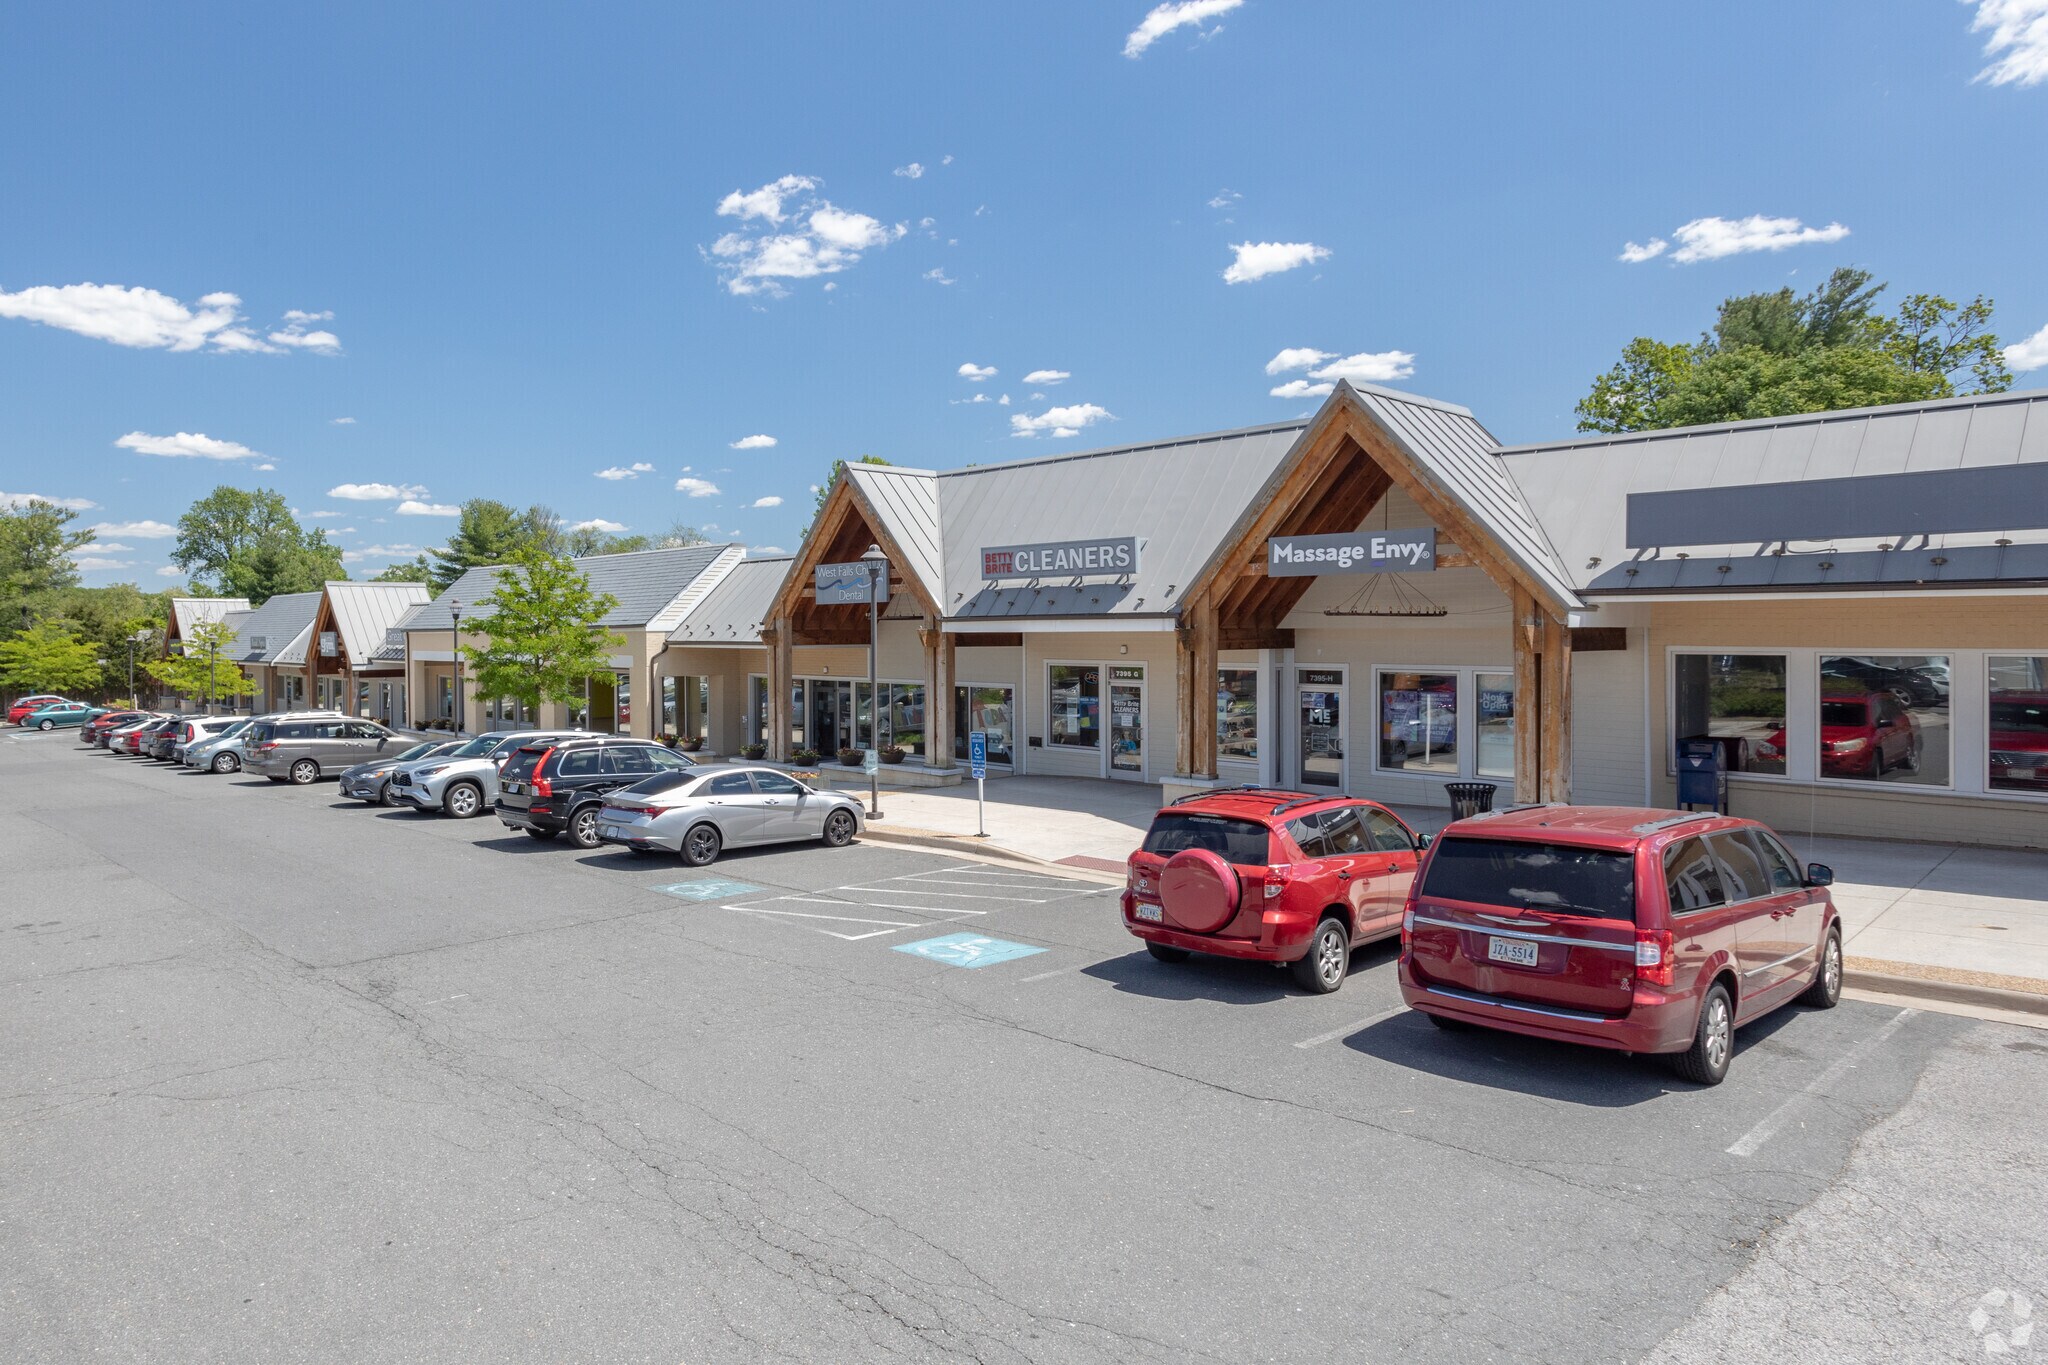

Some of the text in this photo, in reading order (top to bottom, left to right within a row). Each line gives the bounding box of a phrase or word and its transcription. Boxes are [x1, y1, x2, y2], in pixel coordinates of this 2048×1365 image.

[984, 552, 1014, 563] BETTY
[1015, 544, 1131, 573] CLEANERS
[1273, 542, 1365, 568] Massage
[817, 564, 884, 577] West Falls Chuh
[985, 563, 1013, 574] BRITE
[838, 589, 864, 601] Dental
[1309, 674, 1334, 682] 7395-H
[1482, 692, 1505, 701] Now
[1482, 700, 1509, 711] Open
[1492, 943, 1534, 960] JZA-5514
